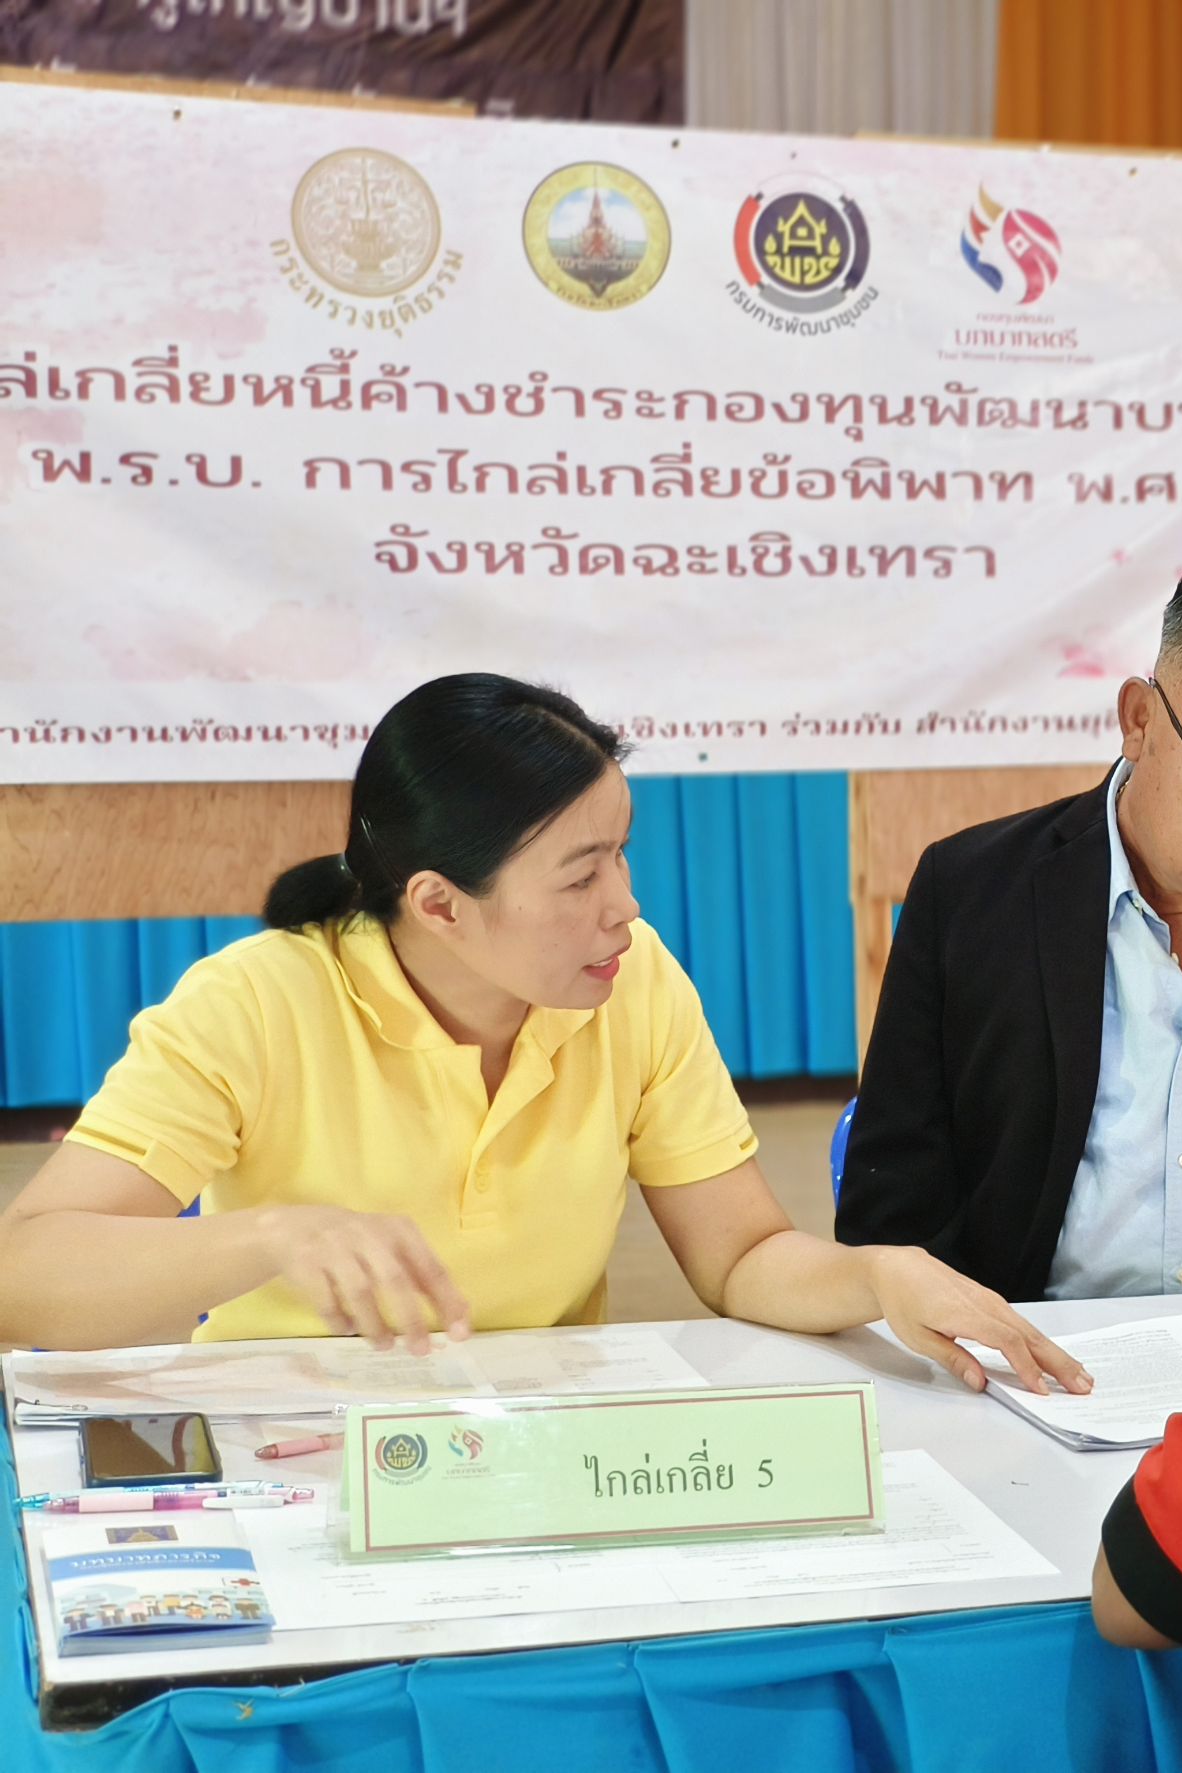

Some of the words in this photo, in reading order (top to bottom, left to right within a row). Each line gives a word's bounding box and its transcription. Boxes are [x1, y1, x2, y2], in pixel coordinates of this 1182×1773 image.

[31, 448, 262, 488] พ.ร.บ.
[302, 442, 1034, 503] การไกล่เกลี่ยข้อพิพาท
[374, 523, 998, 579] จังหวัดฉะเชิงเทรา
[0, 718, 371, 750] ำนักงานพัฒนาชุม
[583, 1438, 735, 1498] ไกล่เกลี่ย
[757, 1458, 775, 1488] 5
